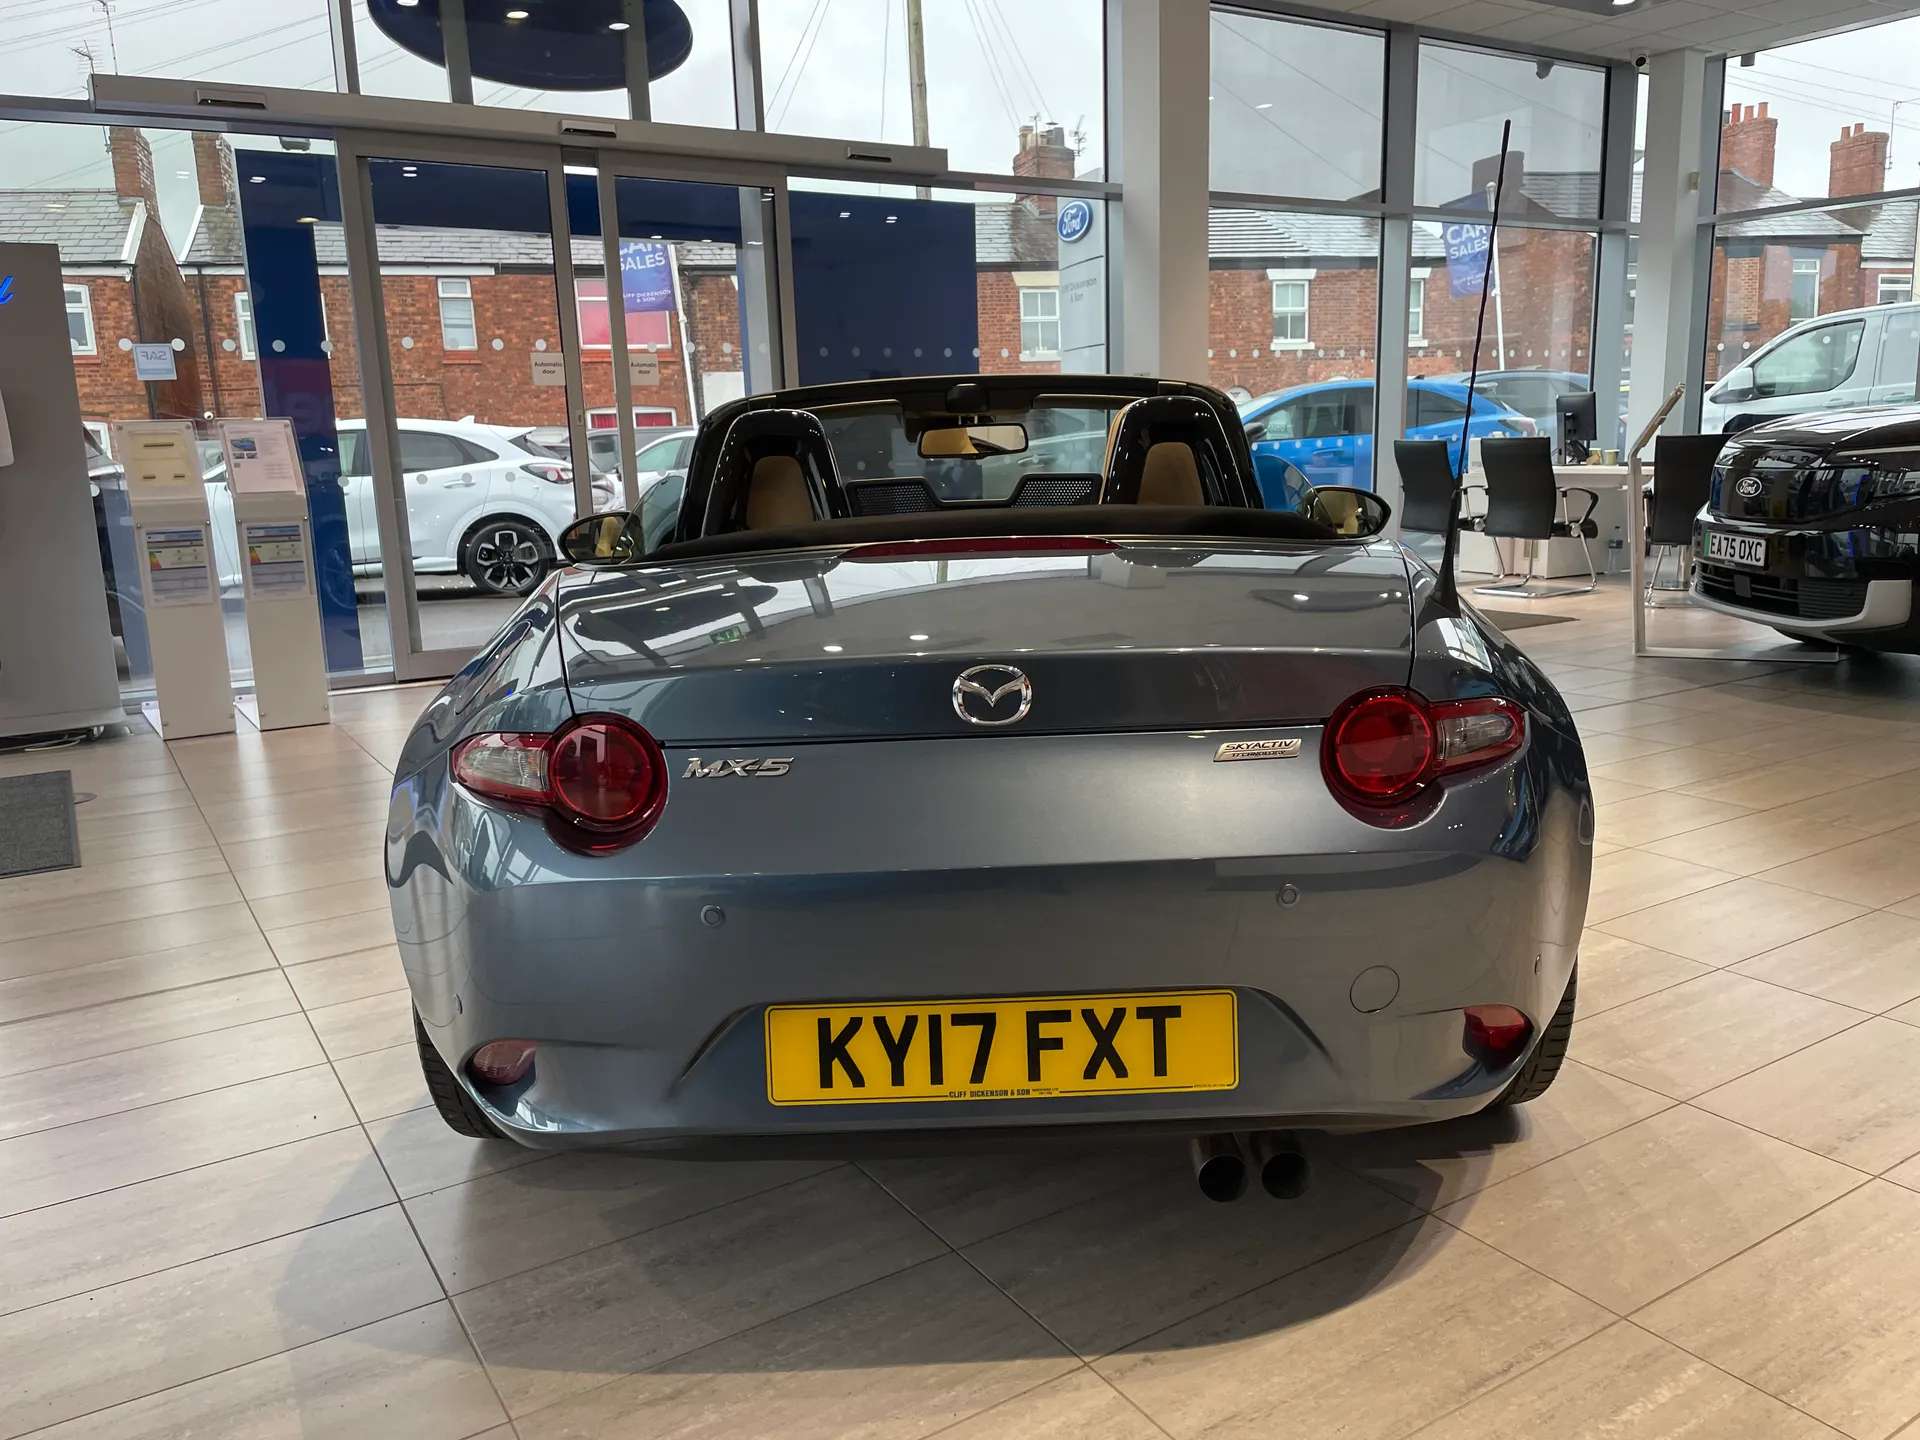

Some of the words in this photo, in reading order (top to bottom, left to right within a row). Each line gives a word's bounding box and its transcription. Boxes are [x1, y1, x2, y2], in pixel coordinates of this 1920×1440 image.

[1449, 237, 1489, 259] SALES
[1710, 534, 1736, 558] EA75
[1738, 539, 1763, 563] OXC
[1224, 740, 1294, 751] SKYACTIV
[681, 757, 795, 778] MX-5
[817, 1012, 997, 1089] KY17
[1025, 1005, 1182, 1082] FXT
[948, 1090, 967, 1099] CLIFF
[969, 1089, 1009, 1098] DICKENSON
[1016, 1088, 1031, 1096] SON
